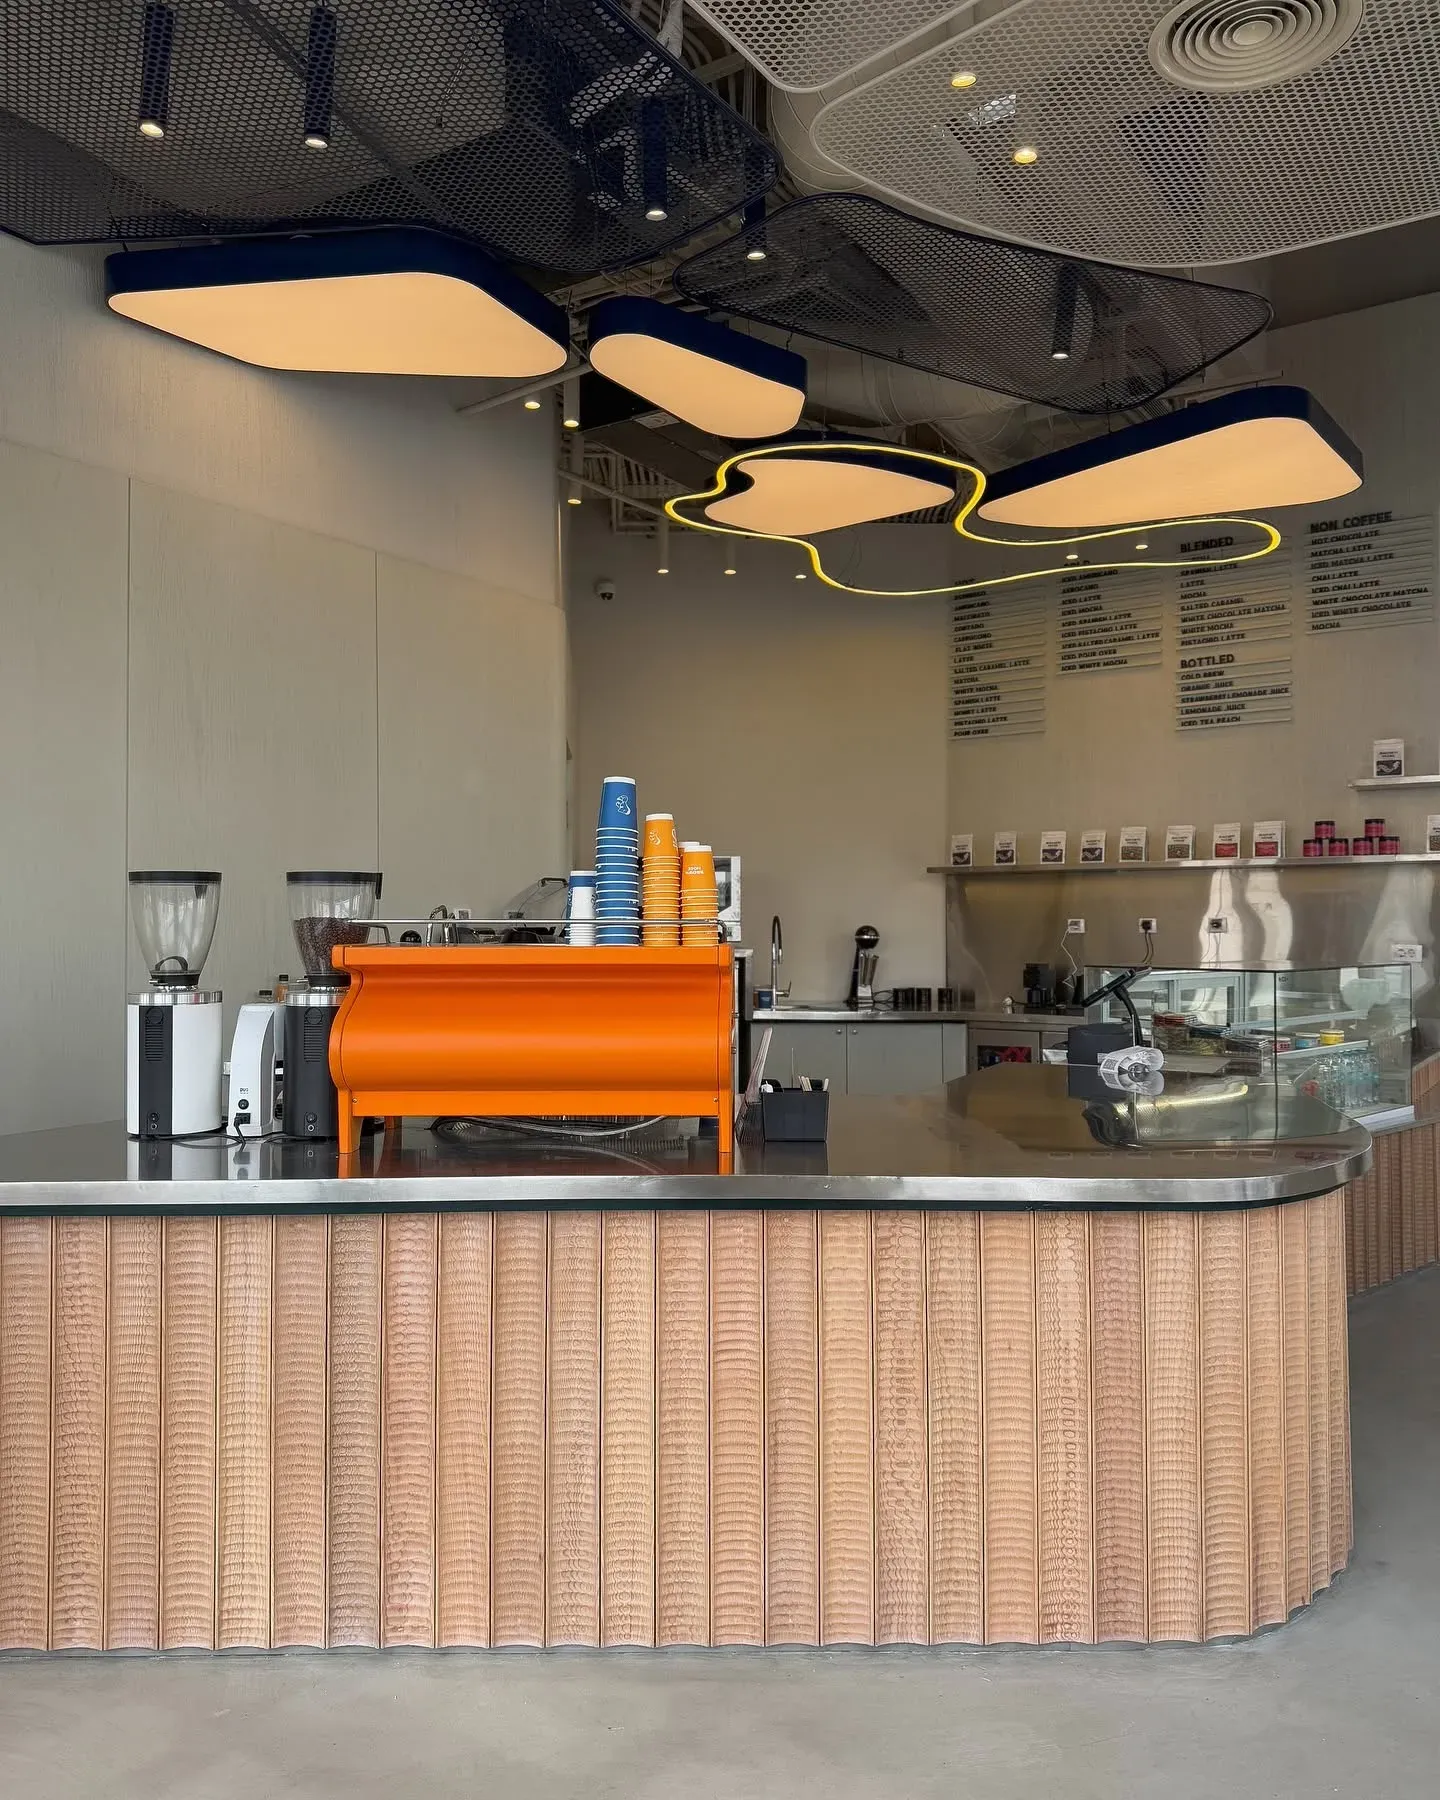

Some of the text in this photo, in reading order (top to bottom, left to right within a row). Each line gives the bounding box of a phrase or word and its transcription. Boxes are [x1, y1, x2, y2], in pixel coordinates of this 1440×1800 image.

[1311, 511, 1392, 533] NON COFFEE
[1331, 530, 1379, 542] CHOCOLATE
[1181, 537, 1234, 553] BLENDED
[1311, 544, 1372, 557] MATCHA LATTE
[1332, 557, 1364, 566] MATCHA
[1367, 553, 1394, 561] LATTE
[1213, 563, 1237, 571] LATTE
[1080, 570, 1118, 579] AMERICANO
[1333, 571, 1358, 579] LATTE
[1181, 580, 1204, 588] LATTE
[1353, 580, 1380, 588] LATTE
[1312, 587, 1428, 605] WHITE CHOCOLATE MATCHA
[1181, 598, 1243, 611] SALTED CARAMEL
[1333, 607, 1358, 615] WHITE
[1361, 601, 1412, 612] CHOCOLATE
[1208, 608, 1251, 619] CHOCOLATE
[1254, 604, 1286, 613] MATCHA
[1079, 616, 1107, 624] SPANISH
[1078, 627, 1113, 636] PISTACHIO
[1181, 622, 1234, 634] WHITE MOCHA
[1312, 622, 1340, 630] MOCHA
[1078, 639, 1103, 647] SALTED
[1104, 636, 1134, 644] CARAMEL
[1181, 633, 1245, 646] PISTACHIO LATTE
[1181, 654, 1235, 668] BOTTLED
[954, 666, 978, 674] SALTED
[980, 663, 1007, 671] CARAMEL
[1181, 683, 1210, 692] ORANGE
[954, 697, 979, 705] SPANISH
[1181, 694, 1226, 703] STRAWBERRY
[1227, 690, 1267, 698] LEMONADE
[1181, 706, 1222, 715] LEMONADE
[988, 716, 1008, 724] LATTE
[1216, 716, 1240, 724] PEACH
